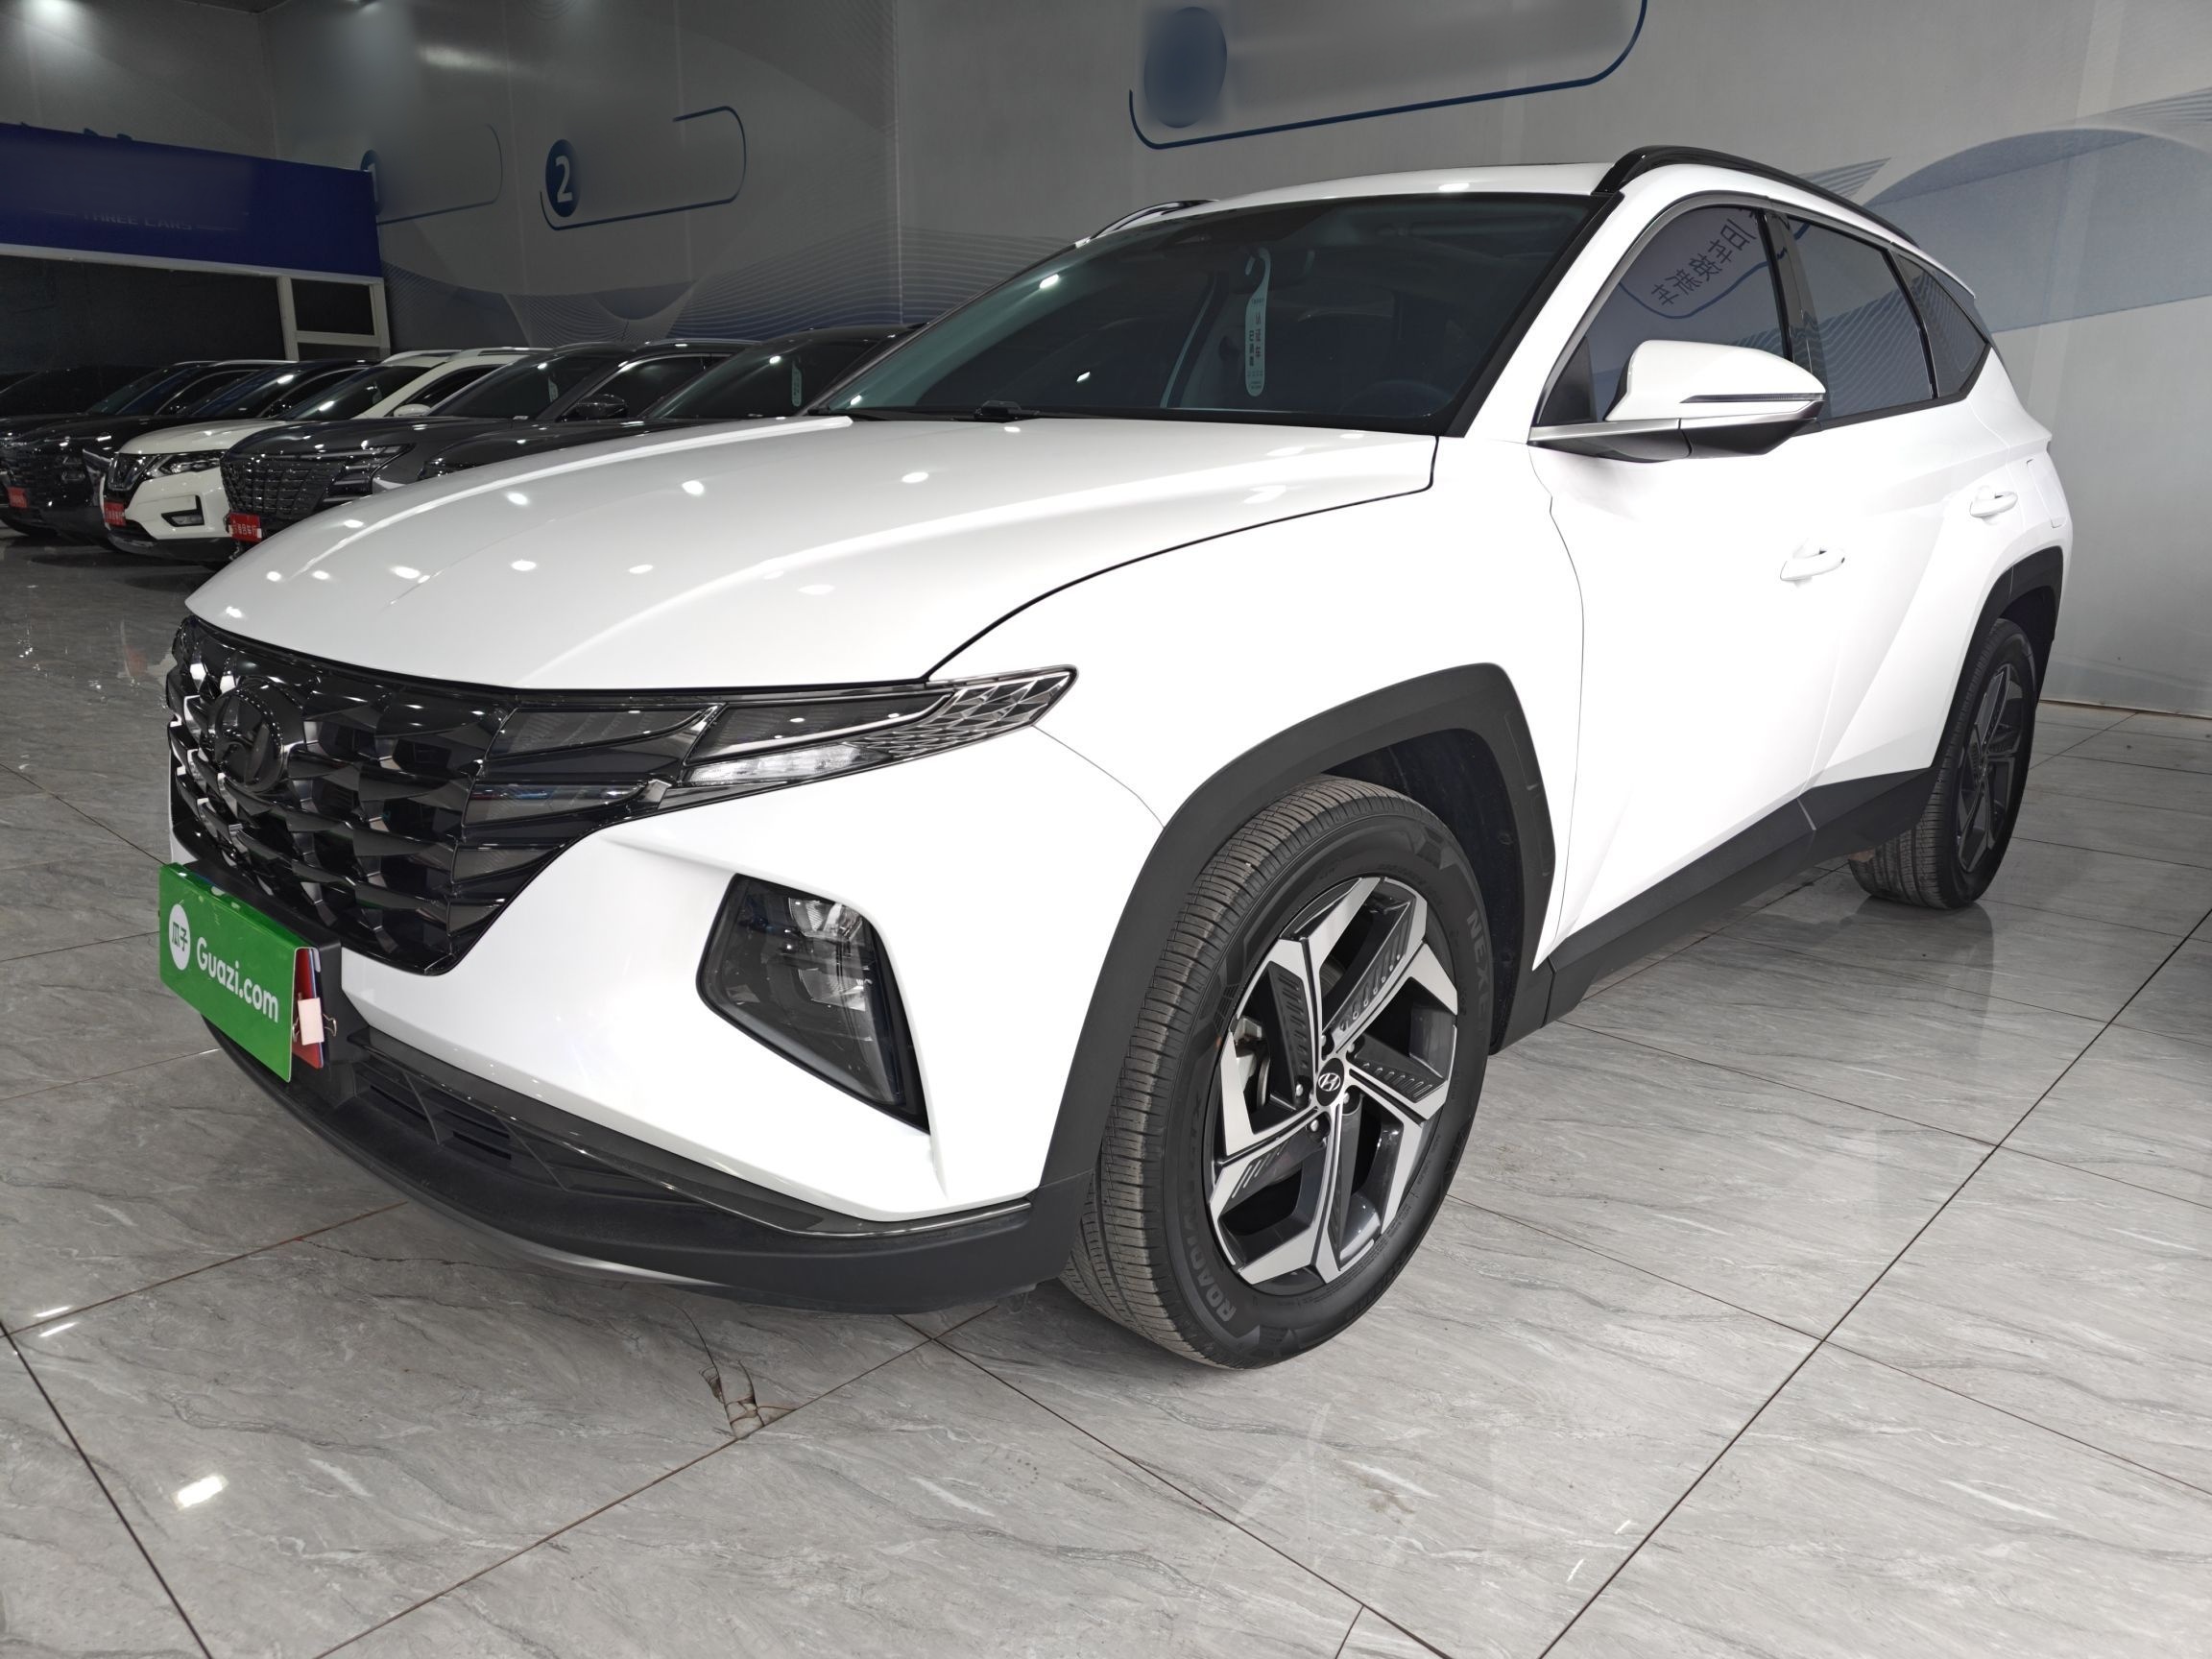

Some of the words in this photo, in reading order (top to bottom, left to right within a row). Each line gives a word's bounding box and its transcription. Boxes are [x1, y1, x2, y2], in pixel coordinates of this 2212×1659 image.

[556, 156, 573, 203] 2
[172, 922, 188, 951] 瓜子
[197, 937, 278, 1023] Guazi.com
[1466, 908, 1492, 1043] NEXE
